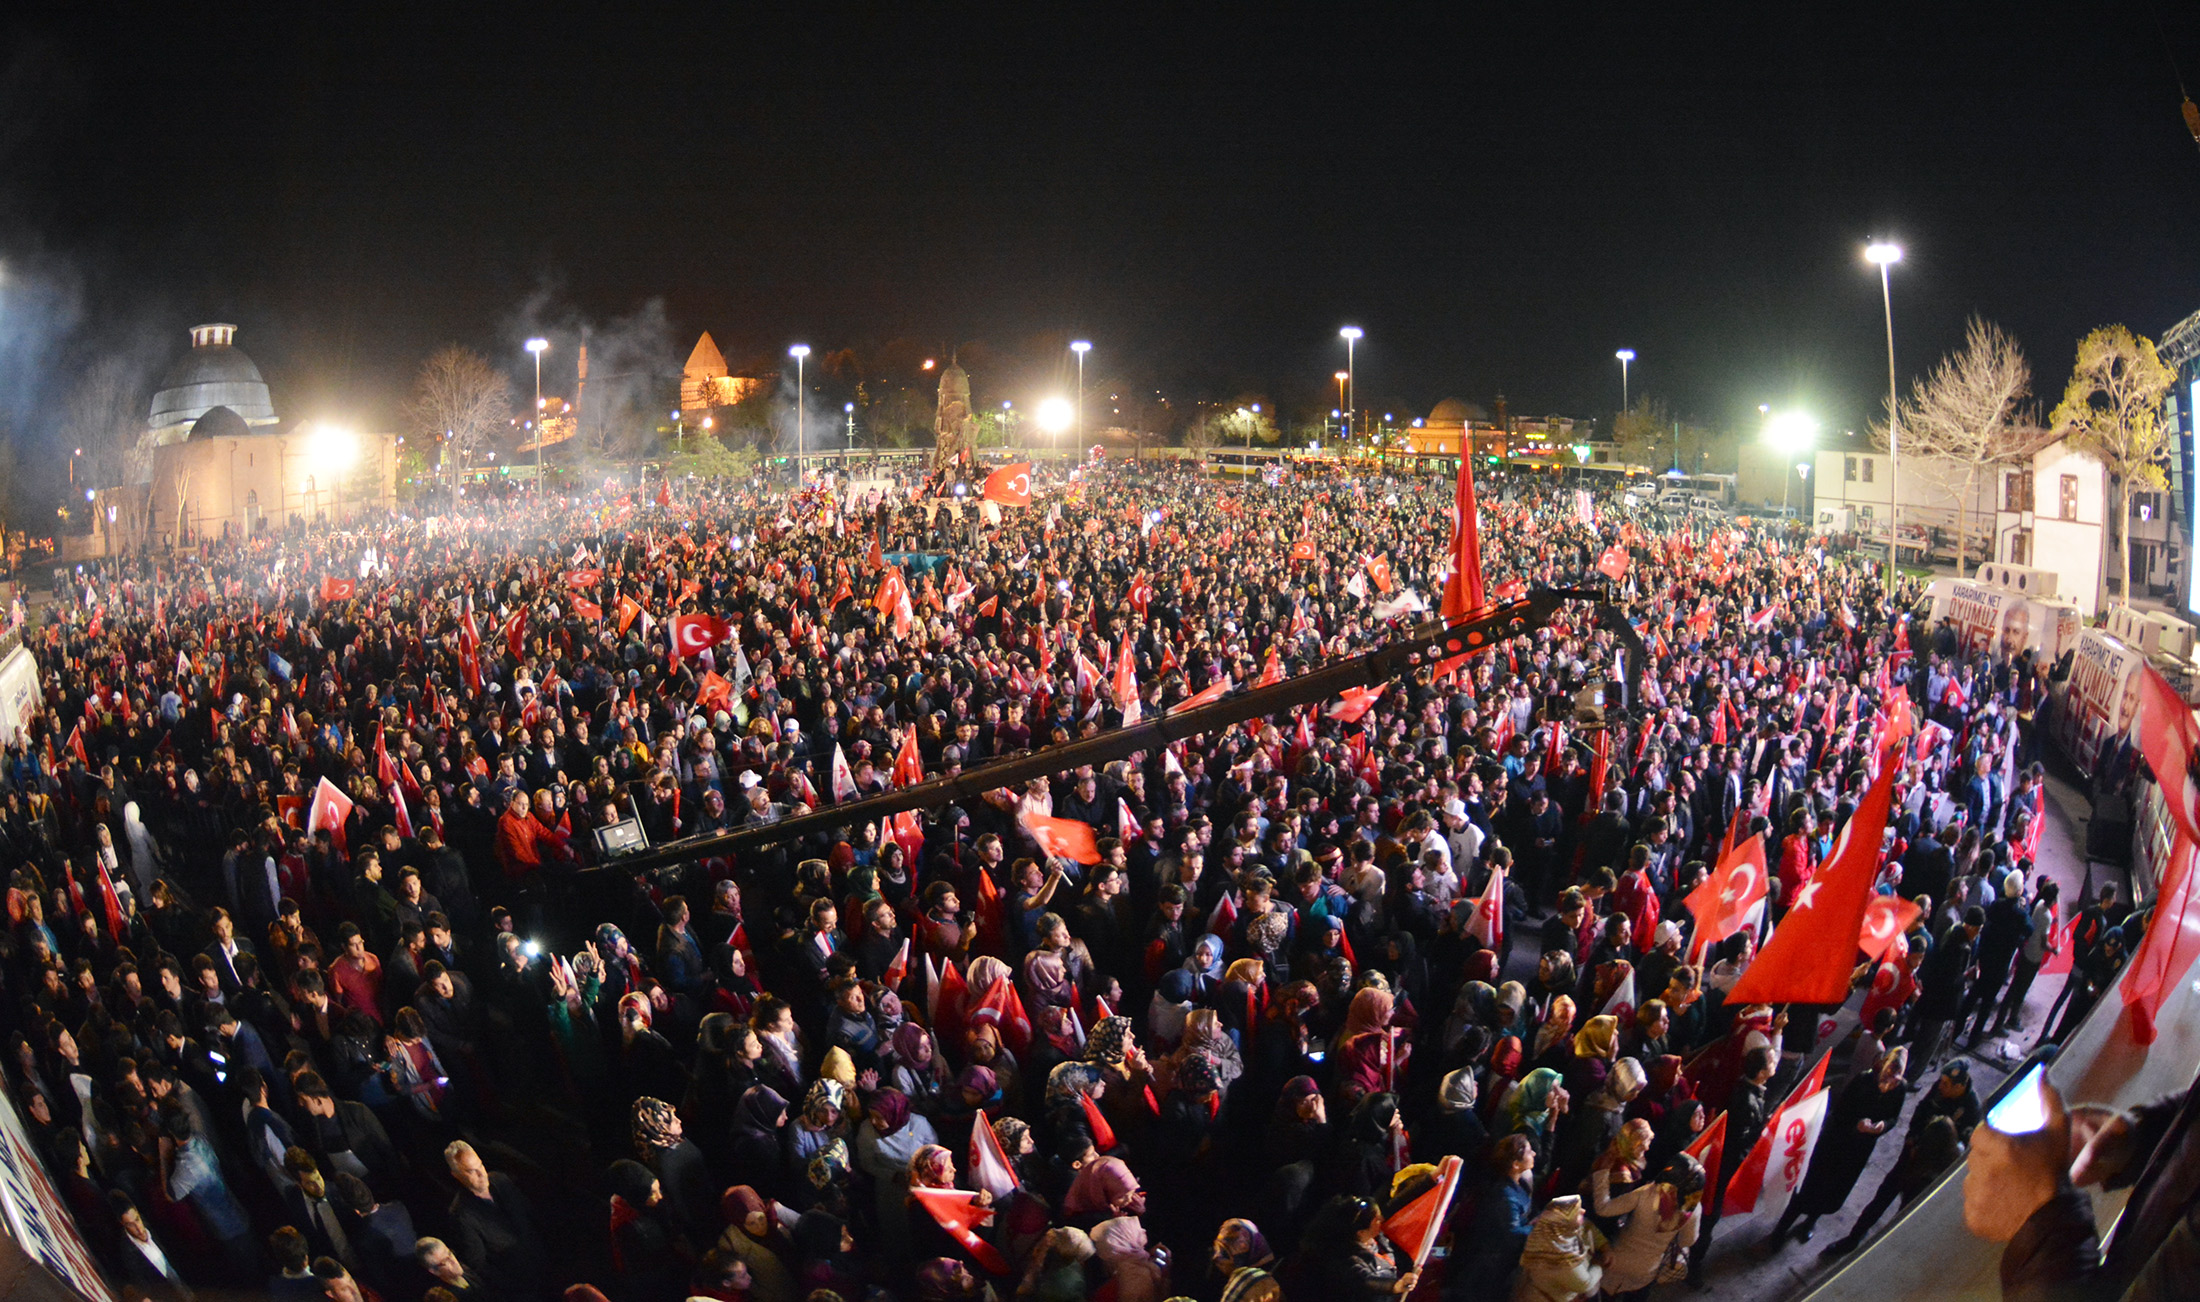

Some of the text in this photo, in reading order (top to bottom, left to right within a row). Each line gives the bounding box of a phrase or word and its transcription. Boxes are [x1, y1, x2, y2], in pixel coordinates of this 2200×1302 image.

[1952, 585, 2002, 608] KARARIMIZ NET
[1948, 598, 1999, 628] OYUMUZ
[1949, 617, 1996, 660] VET
[2109, 653, 2124, 678] NET
[2071, 653, 2118, 712] OYUMUZ
